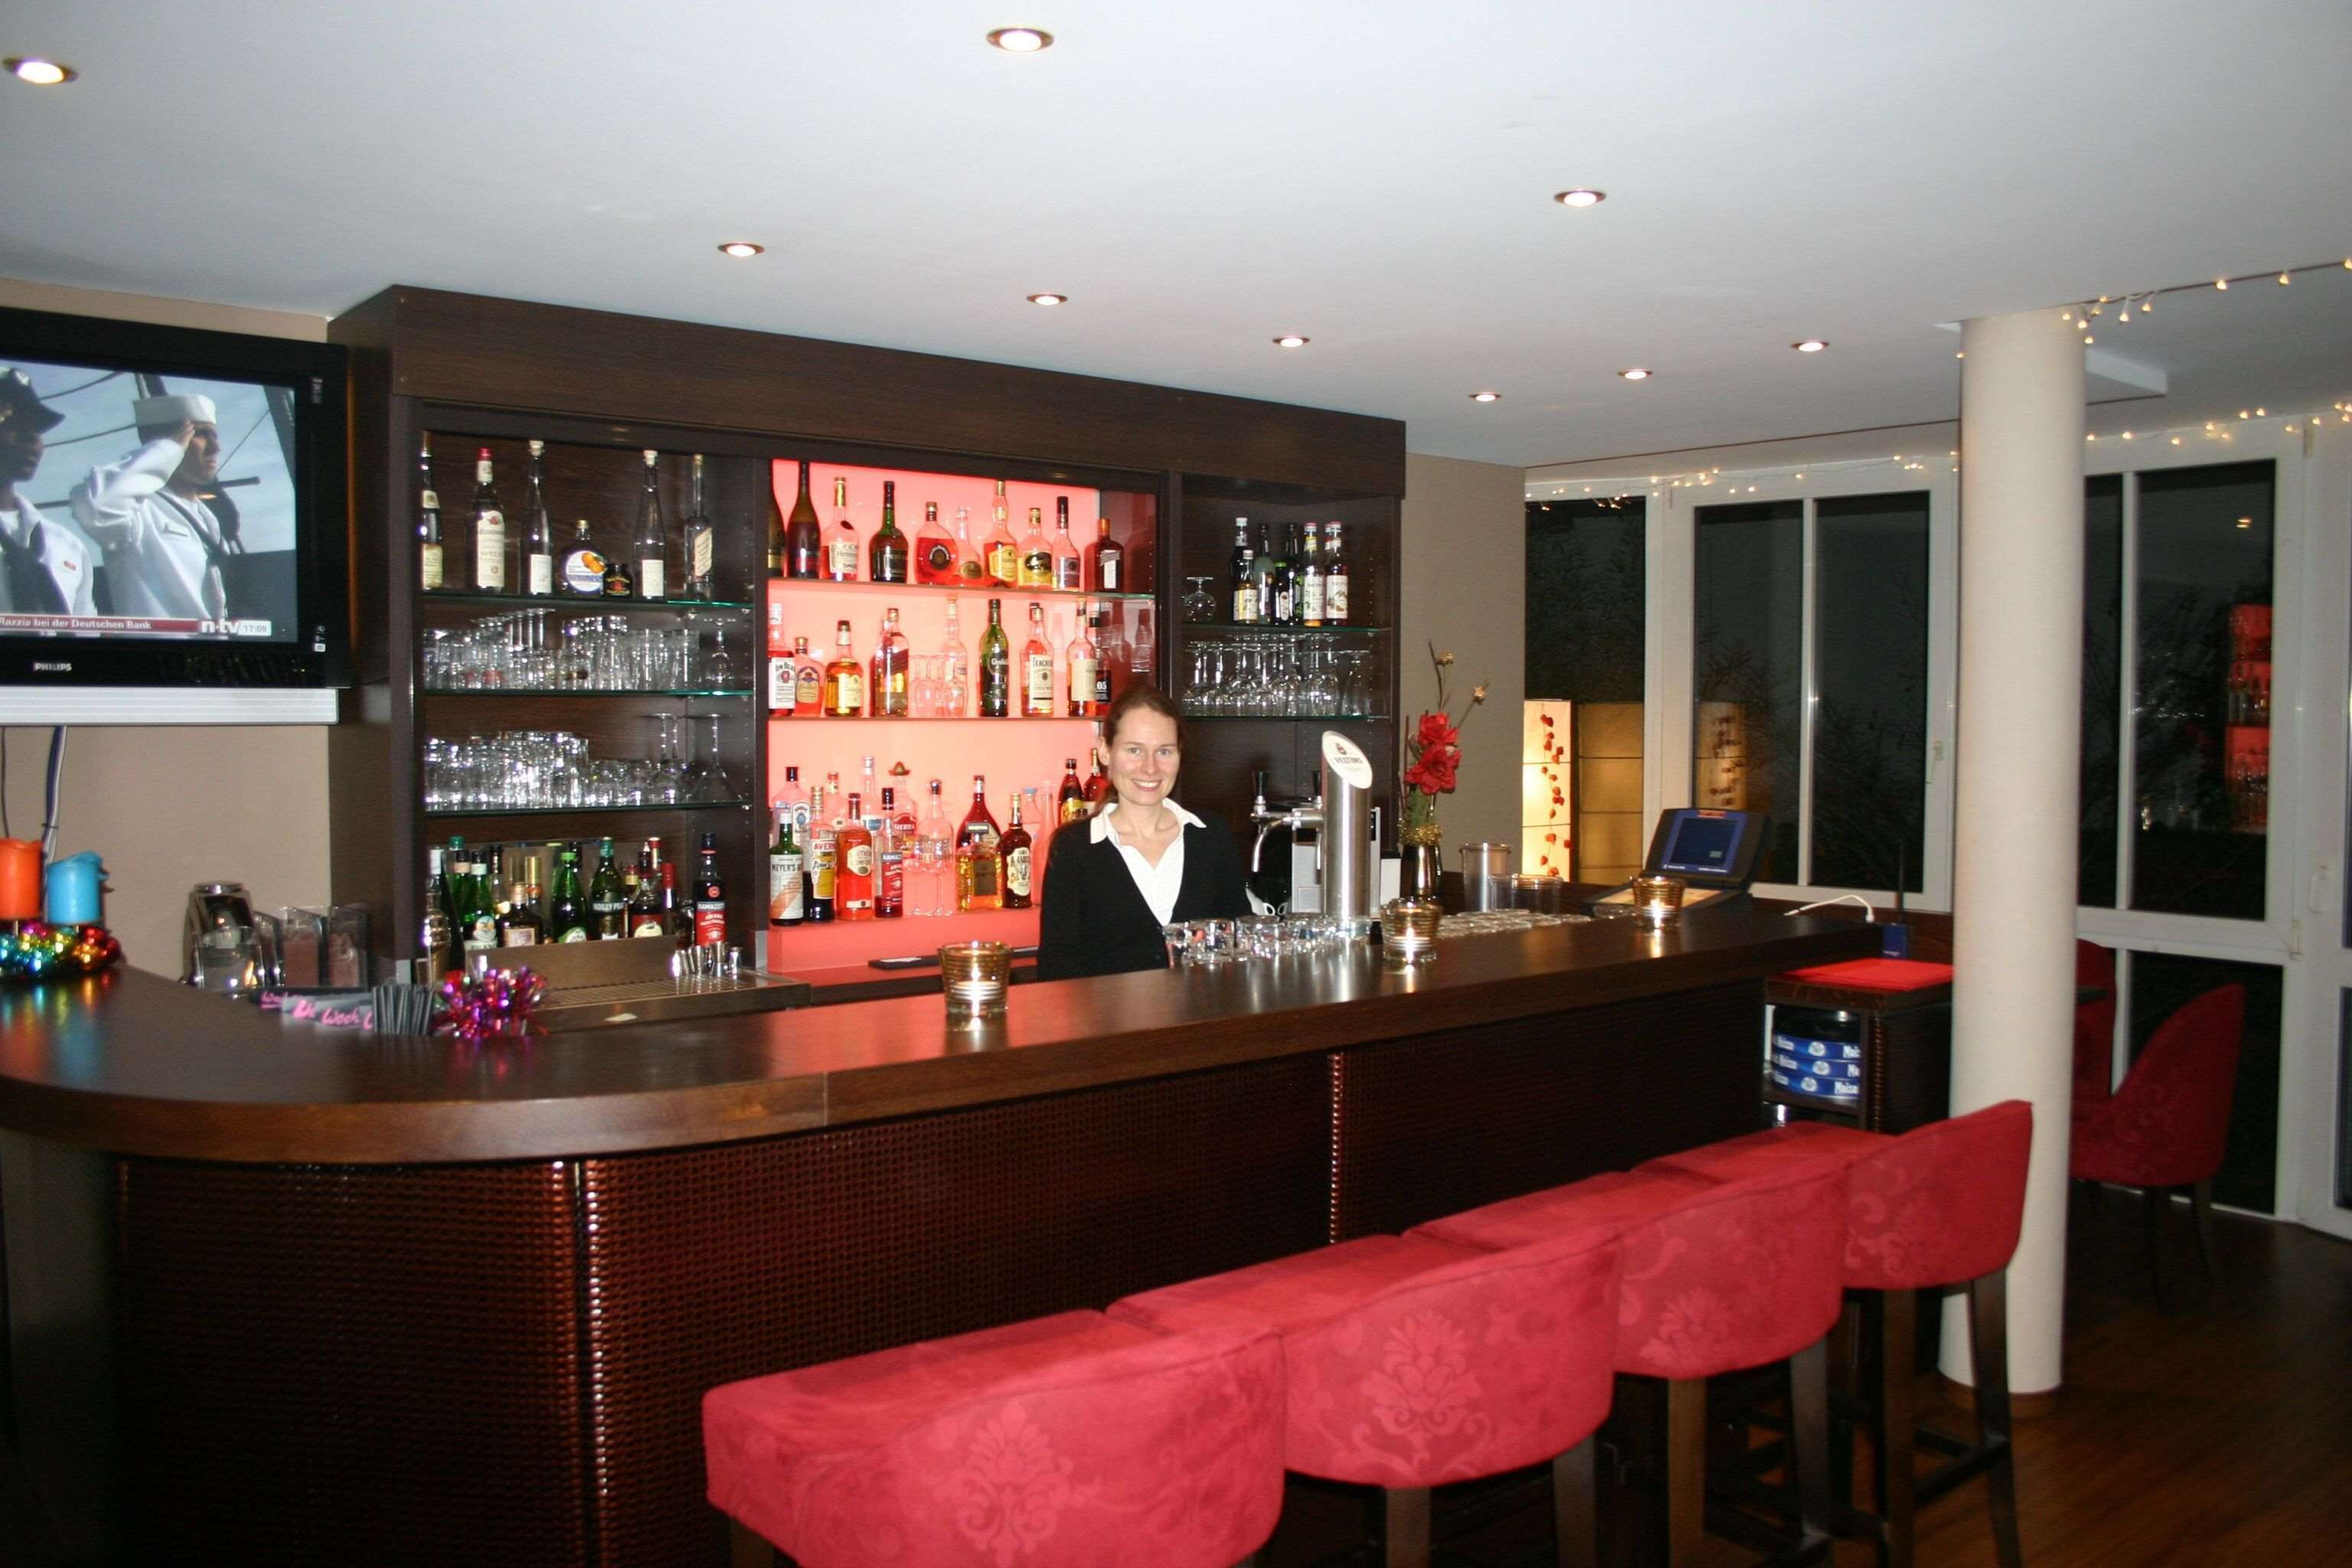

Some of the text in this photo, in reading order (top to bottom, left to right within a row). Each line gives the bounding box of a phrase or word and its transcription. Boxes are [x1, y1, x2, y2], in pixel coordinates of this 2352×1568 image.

[34, 619, 50, 627] bei
[51, 619, 69, 628] der
[71, 619, 124, 629] Deutschen
[126, 621, 152, 630] Bank
[33, 662, 72, 671] PHILIPS
